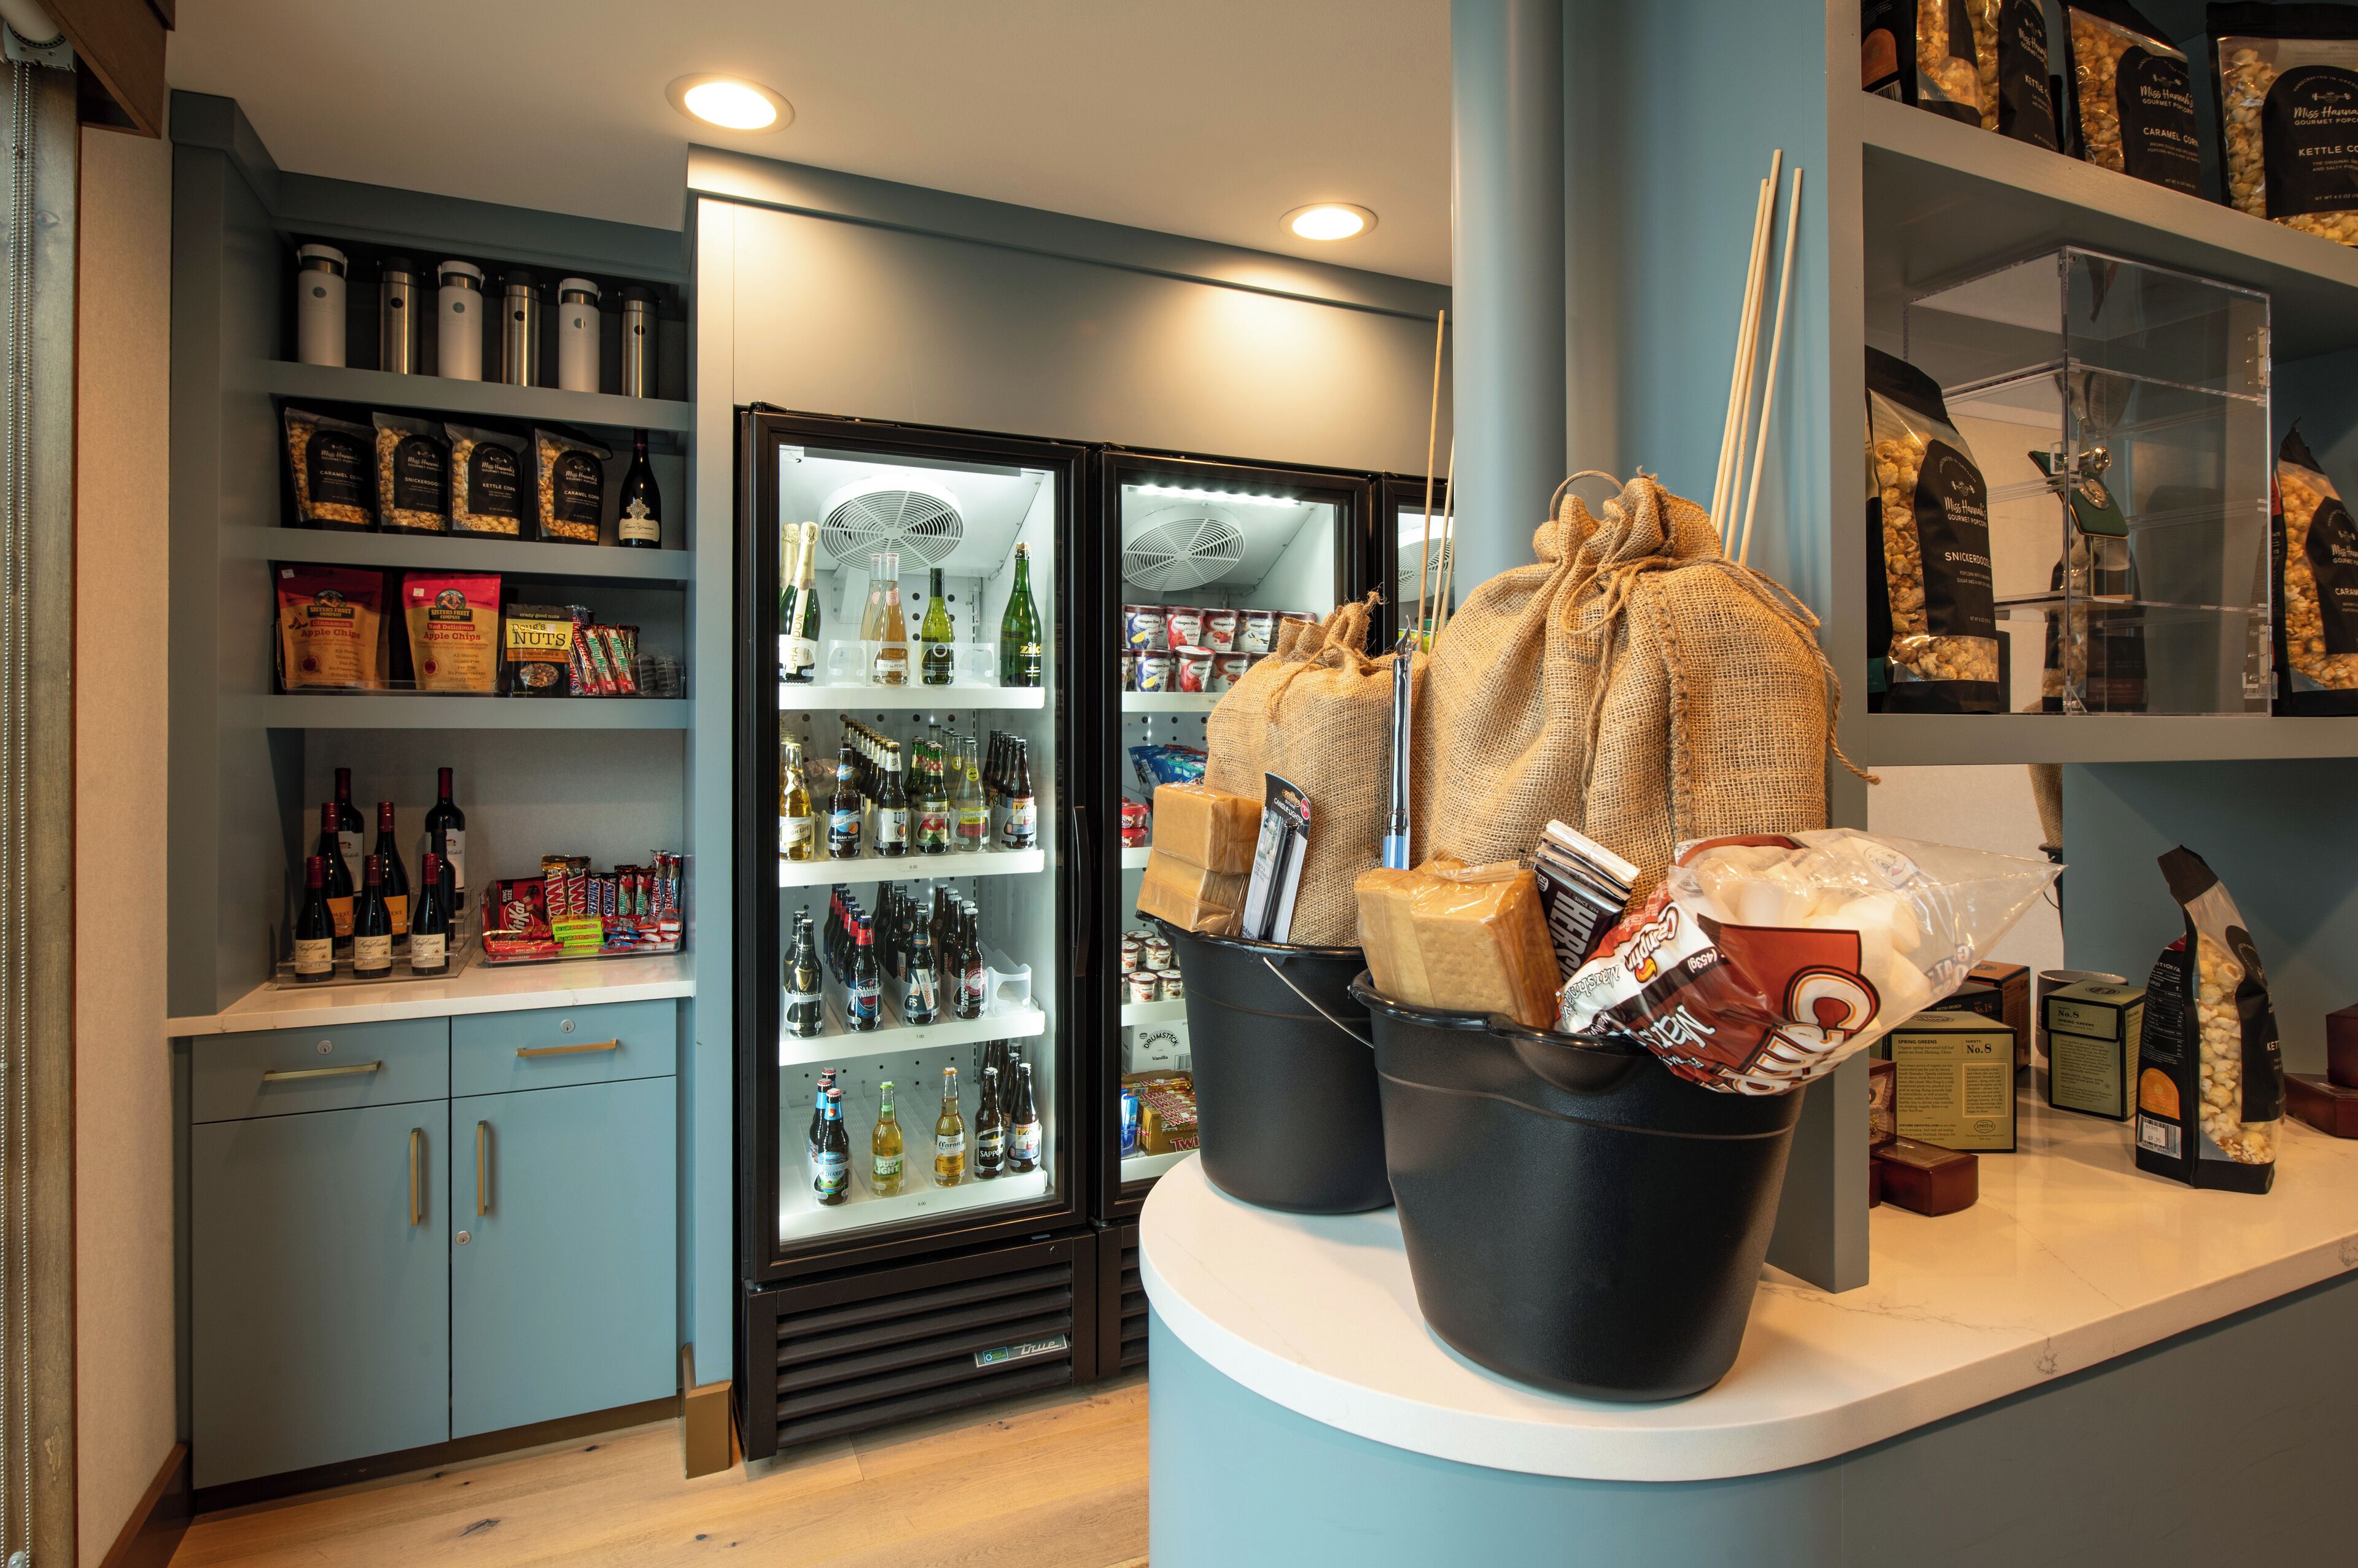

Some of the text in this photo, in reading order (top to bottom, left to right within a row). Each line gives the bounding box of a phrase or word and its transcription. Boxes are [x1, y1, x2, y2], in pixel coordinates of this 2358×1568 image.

[2025, 74, 2044, 94] KETTLE
[2140, 85, 2194, 109] Miss Hannah's
[2142, 98, 2194, 115] GOURMET POPCORN
[2294, 106, 2320, 119] Miss
[2143, 127, 2199, 148] CARAMEL CORN
[2298, 145, 2342, 157] KETTLE
[319, 470, 348, 478] CARAMEL
[481, 461, 515, 474] Miss Hannah's
[564, 490, 587, 499] CARAMEL
[1944, 496, 1987, 521] Miss Hannah's
[1947, 513, 1988, 528] GOURMET POPCORN
[300, 628, 360, 639] Apple Chips
[512, 623, 546, 632] Doug's
[452, 633, 481, 642] Chips
[513, 631, 566, 647] NUTS
[789, 614, 804, 670] CHADON
[587, 637, 608, 673] Milky Way
[609, 637, 628, 673] Milky Way
[1288, 808, 1304, 824] LIGHTER
[1574, 896, 1600, 915] SINCE 1894
[1687, 947, 1718, 974] (453g)
[922, 983, 932, 1011] AMBER
[1974, 1003, 1993, 1013] No.18
[1170, 1132, 1199, 1153] Twi
[874, 1165, 900, 1174] LIGHT
[877, 1158, 897, 1166] BUD
